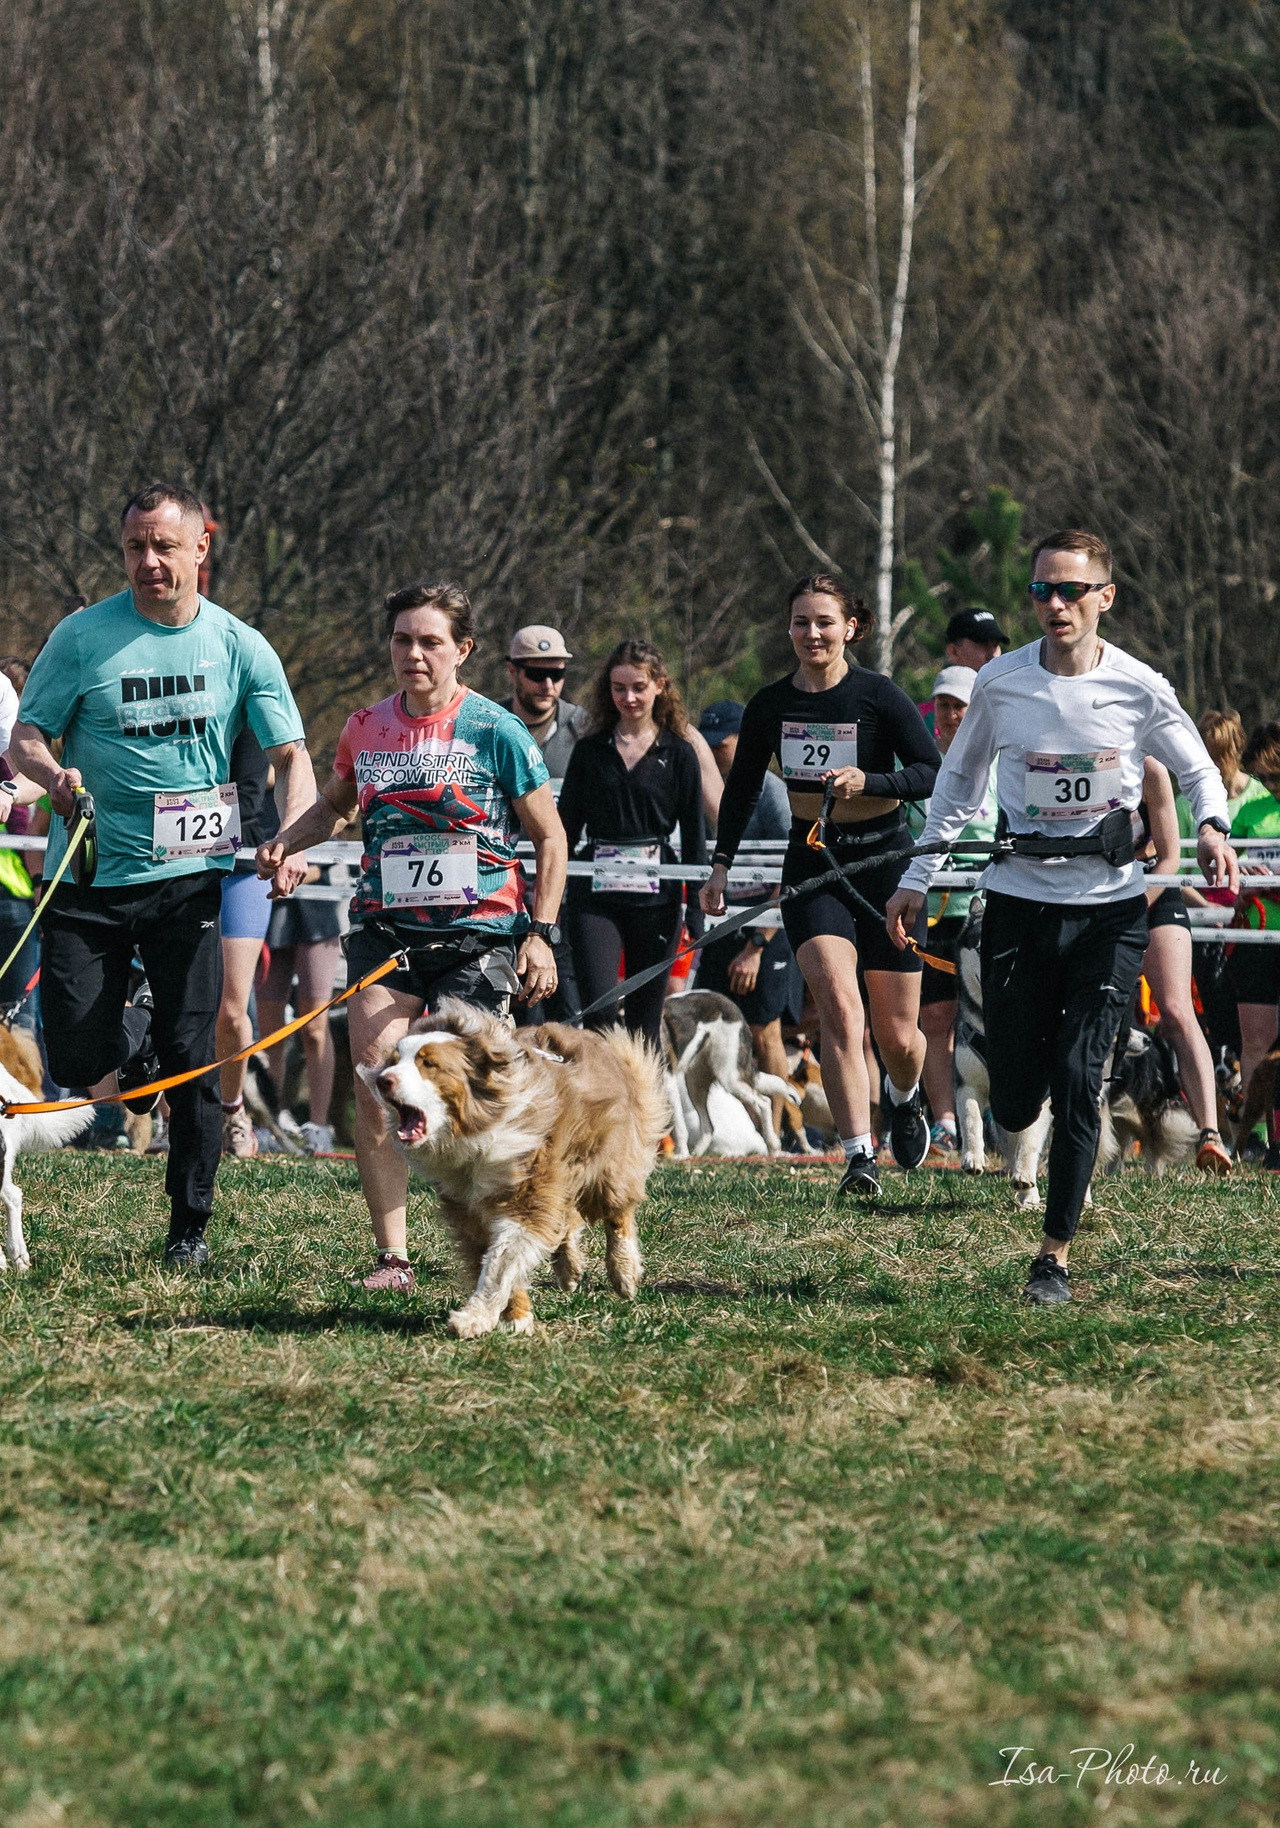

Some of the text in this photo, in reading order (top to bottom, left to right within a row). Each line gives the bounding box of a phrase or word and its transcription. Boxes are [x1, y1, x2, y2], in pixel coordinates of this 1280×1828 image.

[802, 744, 831, 766] 29
[355, 768, 423, 784] MOSCOW
[1054, 777, 1091, 803] 30
[176, 812, 223, 841] 123
[408, 860, 444, 888] 76
